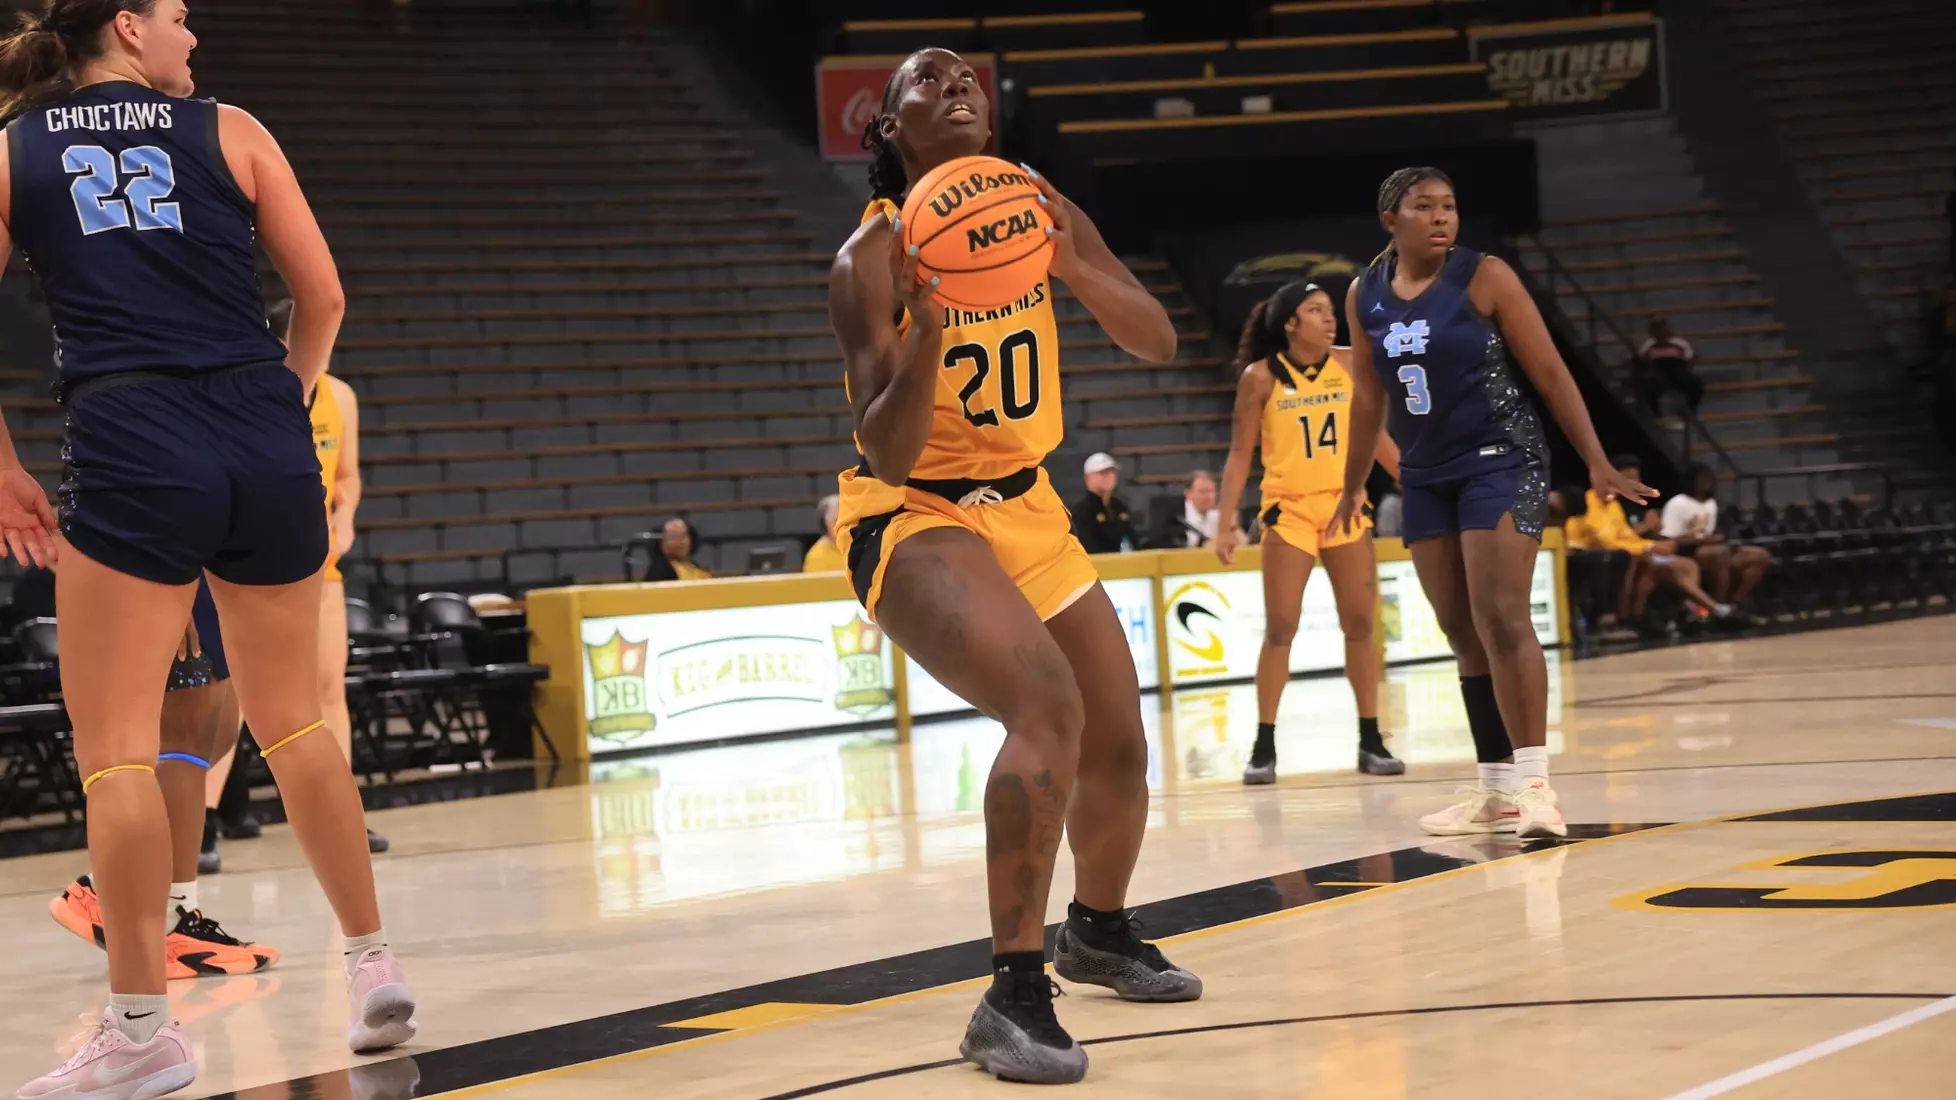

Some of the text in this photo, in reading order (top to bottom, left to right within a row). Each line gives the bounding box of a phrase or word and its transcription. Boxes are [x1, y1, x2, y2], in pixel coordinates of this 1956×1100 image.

[1489, 40, 1650, 79] SOUTHERN
[1532, 76, 1594, 106] MISS
[46, 102, 172, 132] CHOCTAWS
[61, 145, 184, 236] 22
[928, 172, 1031, 218] Wilson
[966, 208, 1038, 253] NCAA
[943, 328, 1040, 428] 20
[1397, 364, 1432, 415] 3
[1276, 393, 1329, 411] SOUTHERN
[1298, 411, 1337, 459] 14
